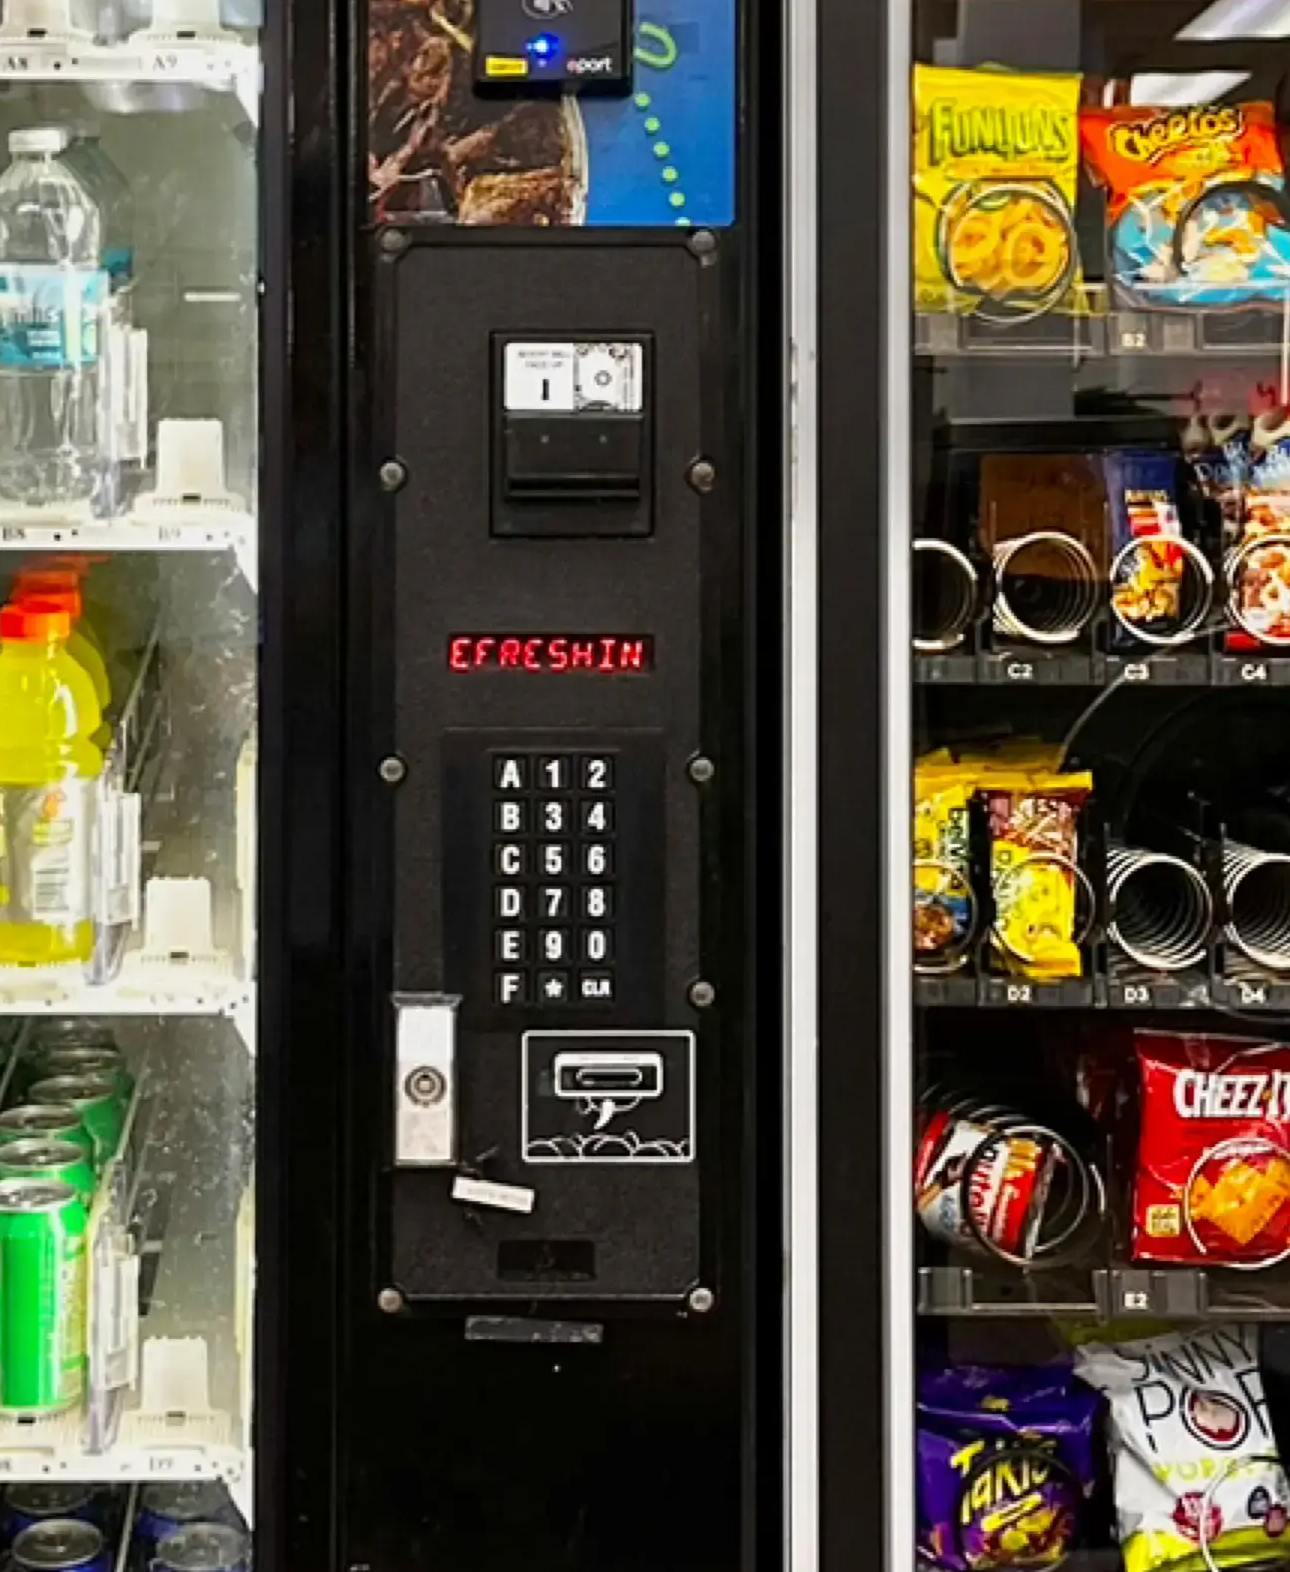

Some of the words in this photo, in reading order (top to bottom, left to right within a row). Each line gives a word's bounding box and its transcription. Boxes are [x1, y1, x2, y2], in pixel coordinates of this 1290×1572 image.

[930, 98, 1071, 166] FUNYUNS
[1111, 103, 1245, 162] Cheetos
[449, 637, 643, 670] EFRESHIN
[499, 759, 521, 789] A
[545, 759, 561, 789] 1
[586, 759, 607, 789] 2
[499, 803, 521, 832] B
[543, 803, 564, 832] 3
[586, 803, 607, 832] 4
[499, 845, 521, 875] C
[543, 845, 564, 875] 5
[586, 845, 607, 875] 6
[499, 888, 521, 917] D
[543, 888, 564, 917] 7
[586, 888, 607, 917] 8
[499, 931, 521, 960] E
[543, 931, 564, 960] 9
[586, 931, 607, 960] 0
[499, 974, 521, 1004] F
